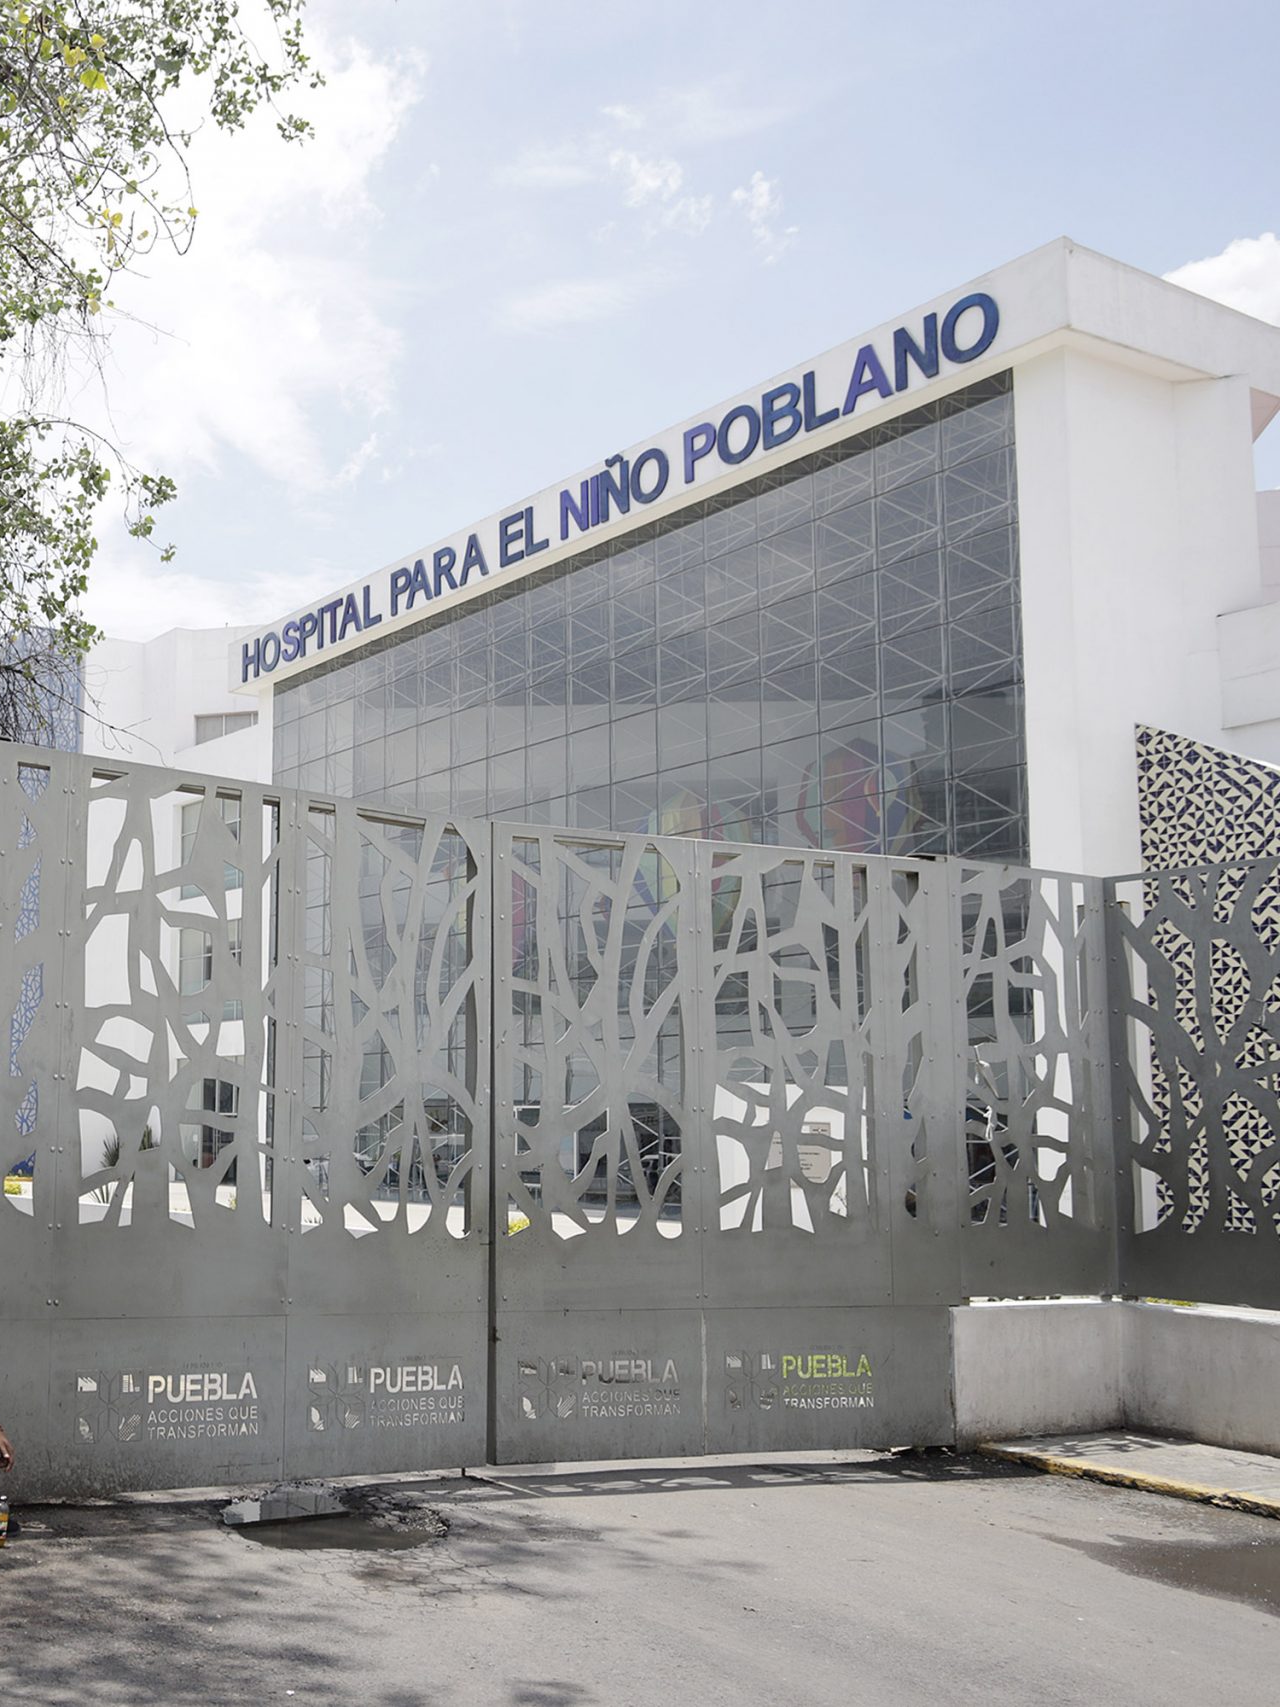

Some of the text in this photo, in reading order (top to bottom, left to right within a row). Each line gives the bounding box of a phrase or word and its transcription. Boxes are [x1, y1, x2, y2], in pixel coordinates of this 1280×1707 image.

[241, 292, 1000, 684] HOSPITAL PARA EL NIÑO POBLANO
[582, 1359, 679, 1386] PUEBLA
[782, 1354, 872, 1379] PUEBLA
[147, 1371, 258, 1404] PUEBLA
[369, 1364, 464, 1394] PUEBLA
[582, 1390, 650, 1404] ACCIONES
[782, 1383, 873, 1396] ACCIONES QUE
[370, 1395, 465, 1413] ACCIONES QUE
[582, 1403, 681, 1418] TRANSFORMAN
[783, 1396, 875, 1410] TRANSFORMAN
[147, 1405, 258, 1424] ACCIONES QUE
[369, 1411, 465, 1428] TRANSFORMAN
[147, 1422, 259, 1441] TRANSFORMAN
